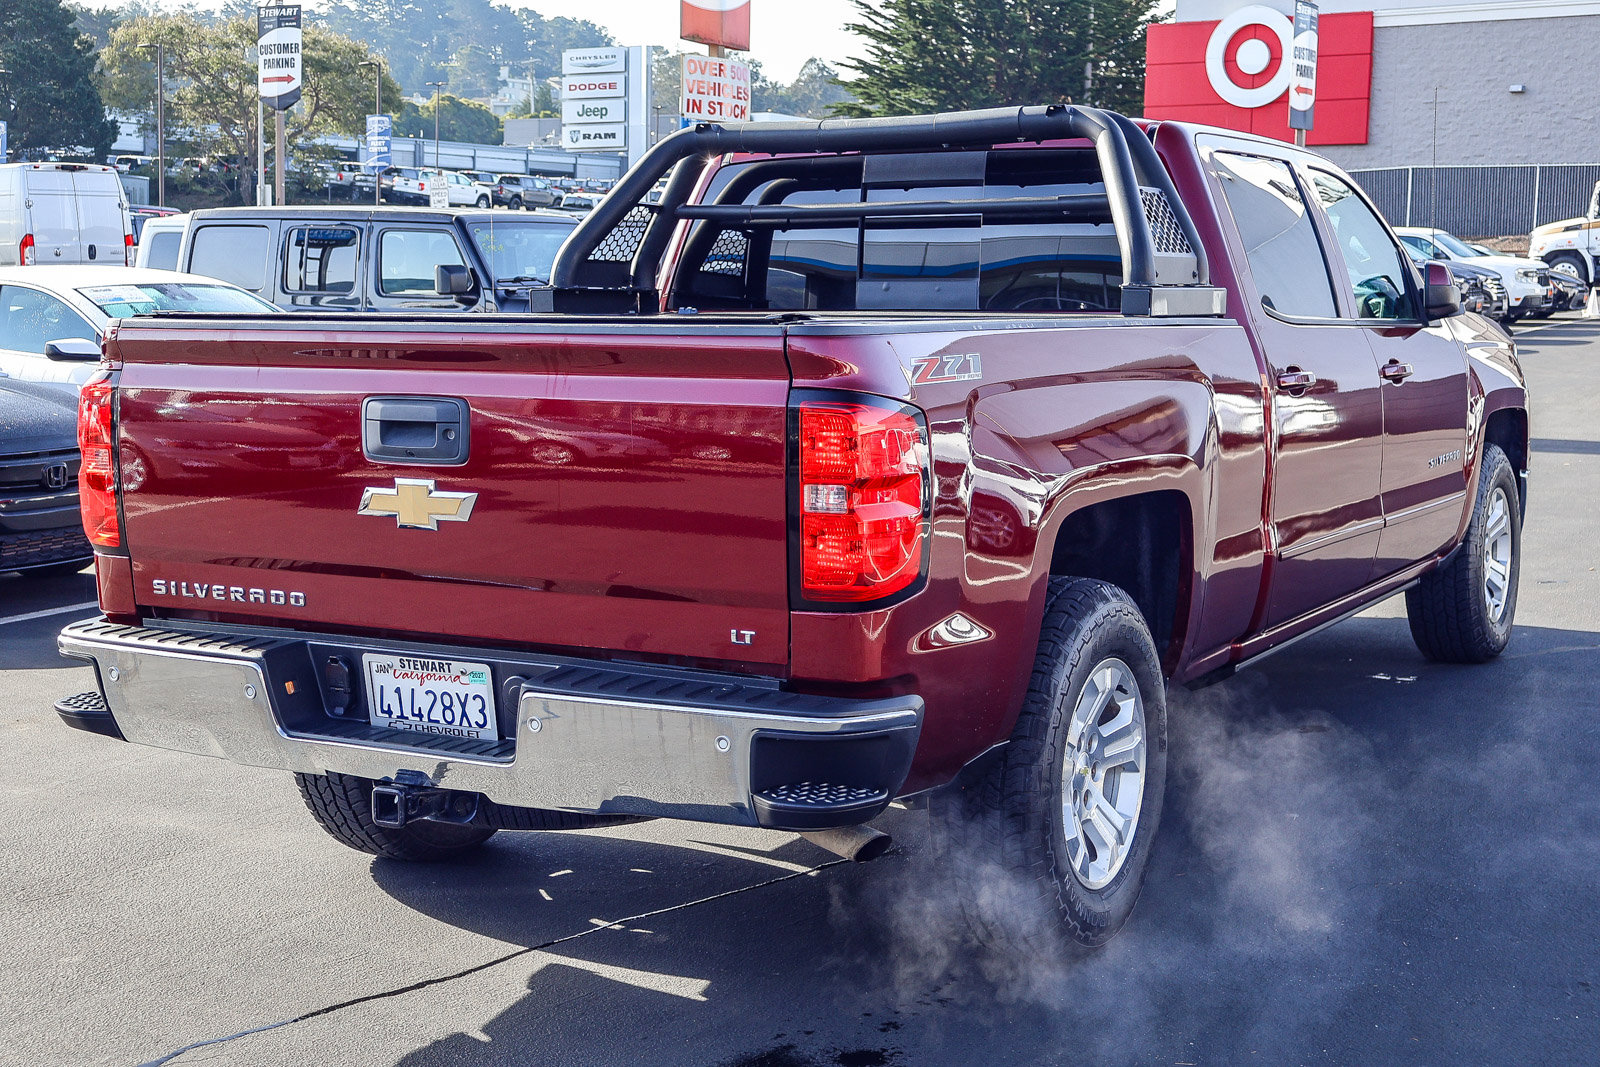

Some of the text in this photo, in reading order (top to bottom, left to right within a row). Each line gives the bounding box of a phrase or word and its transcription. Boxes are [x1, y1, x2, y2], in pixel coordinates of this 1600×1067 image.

[259, 7, 299, 18] STEWART
[259, 43, 300, 56] CUSTOMER
[263, 57, 296, 70] PARKING
[569, 54, 617, 62] CHRYSLER
[687, 58, 728, 78] OVER
[568, 82, 618, 92] DODGE
[685, 78, 750, 102] VEHICLES
[576, 104, 608, 119] Jeep
[686, 98, 748, 121] IN STOCK
[582, 132, 617, 140] RAM
[910, 353, 983, 386] Z71
[152, 579, 306, 608] SILVERADO
[730, 629, 756, 645] LT
[374, 663, 391, 674] JAN
[399, 657, 452, 674] STEWART
[393, 668, 470, 687] California
[378, 684, 489, 729] 41428X3
[414, 723, 481, 739] CHEVROLET
